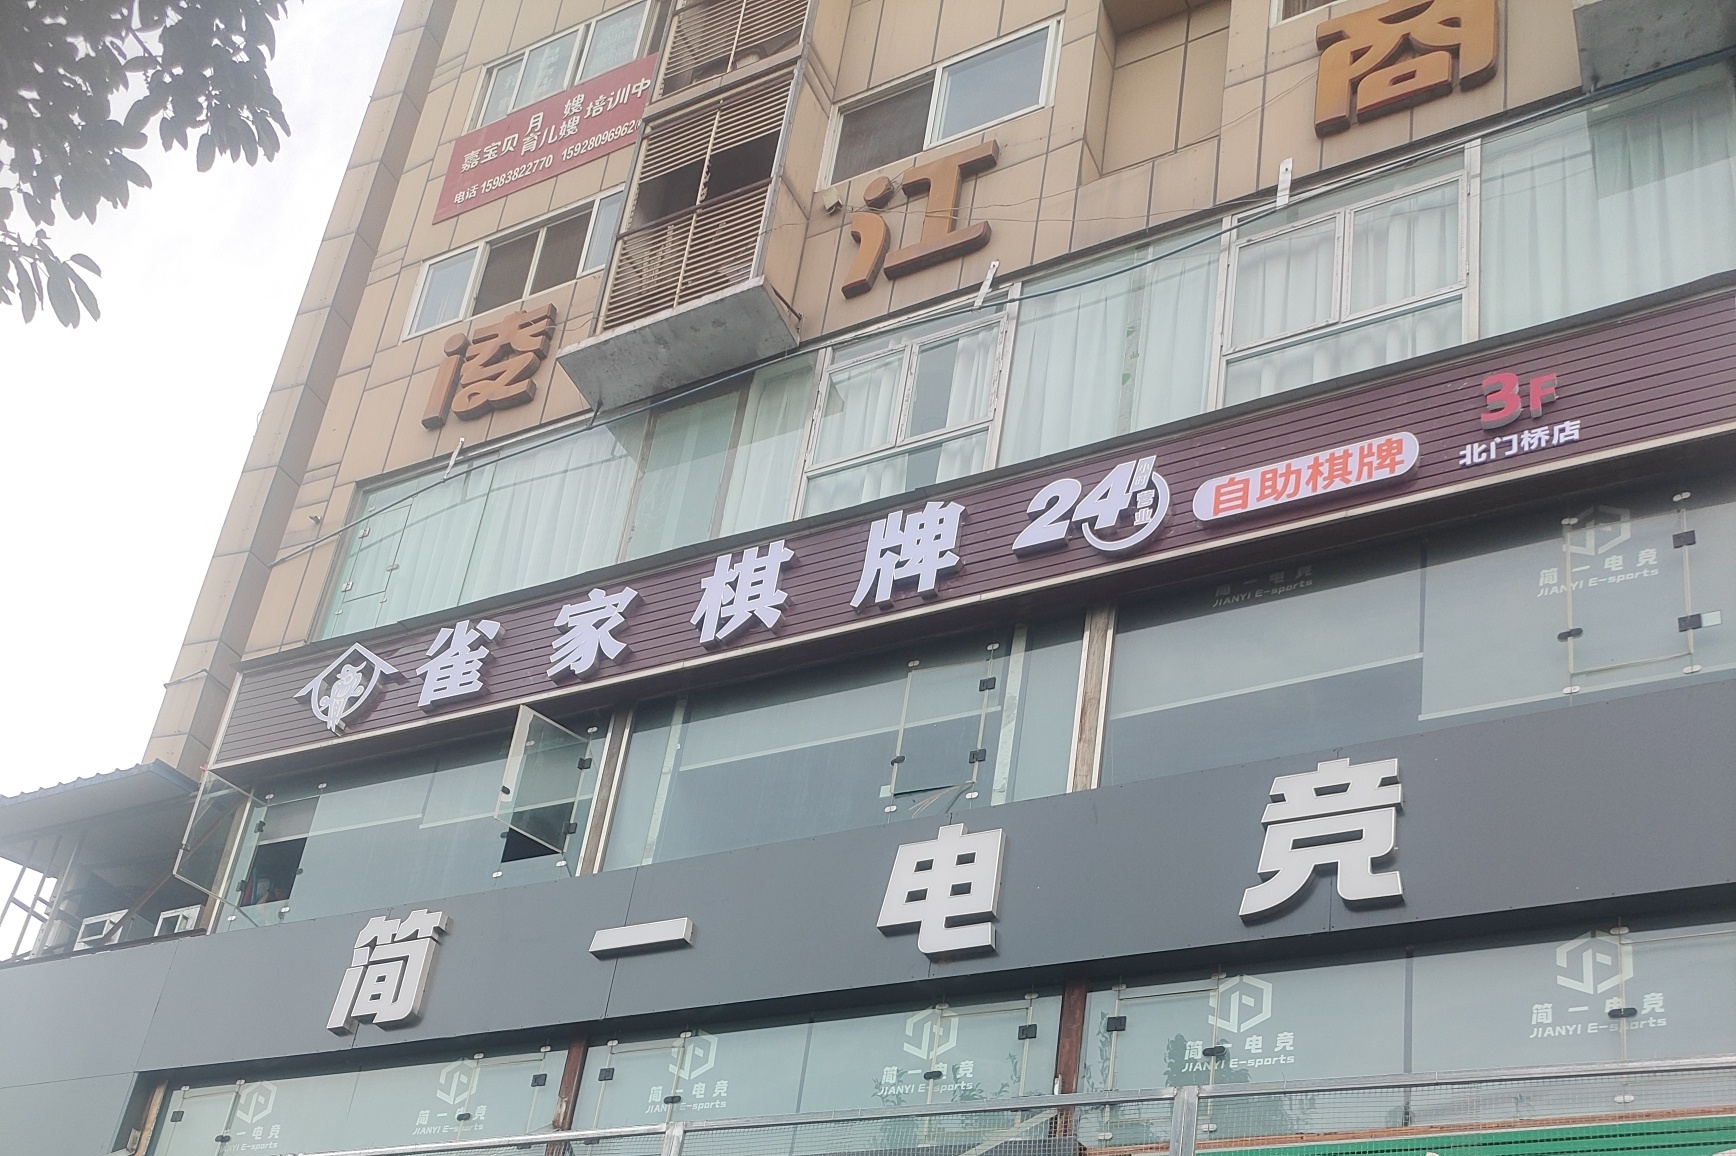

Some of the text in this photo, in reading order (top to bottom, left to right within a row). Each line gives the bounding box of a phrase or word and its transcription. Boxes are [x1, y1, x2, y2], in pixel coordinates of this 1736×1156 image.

[521, 115, 580, 156] 育儿嫂
[525, 93, 585, 136] 月嫂
[461, 133, 518, 173] 嘉宝贝
[454, 183, 479, 204] 电话
[480, 154, 553, 194] 15983822770
[1481, 372, 1557, 430] 3F
[1459, 420, 1580, 466] 北门桥店
[1212, 437, 1407, 517] 自助棋牌
[1012, 458, 1138, 552] 24
[1133, 489, 1156, 526] 营业
[1538, 549, 1657, 586] 简一电竞
[1587, 567, 1659, 587] E-sports
[415, 501, 967, 713] 雀家棋牌
[1529, 1024, 1582, 1038] JIANYI
[1229, 1055, 1295, 1068] E-sports
